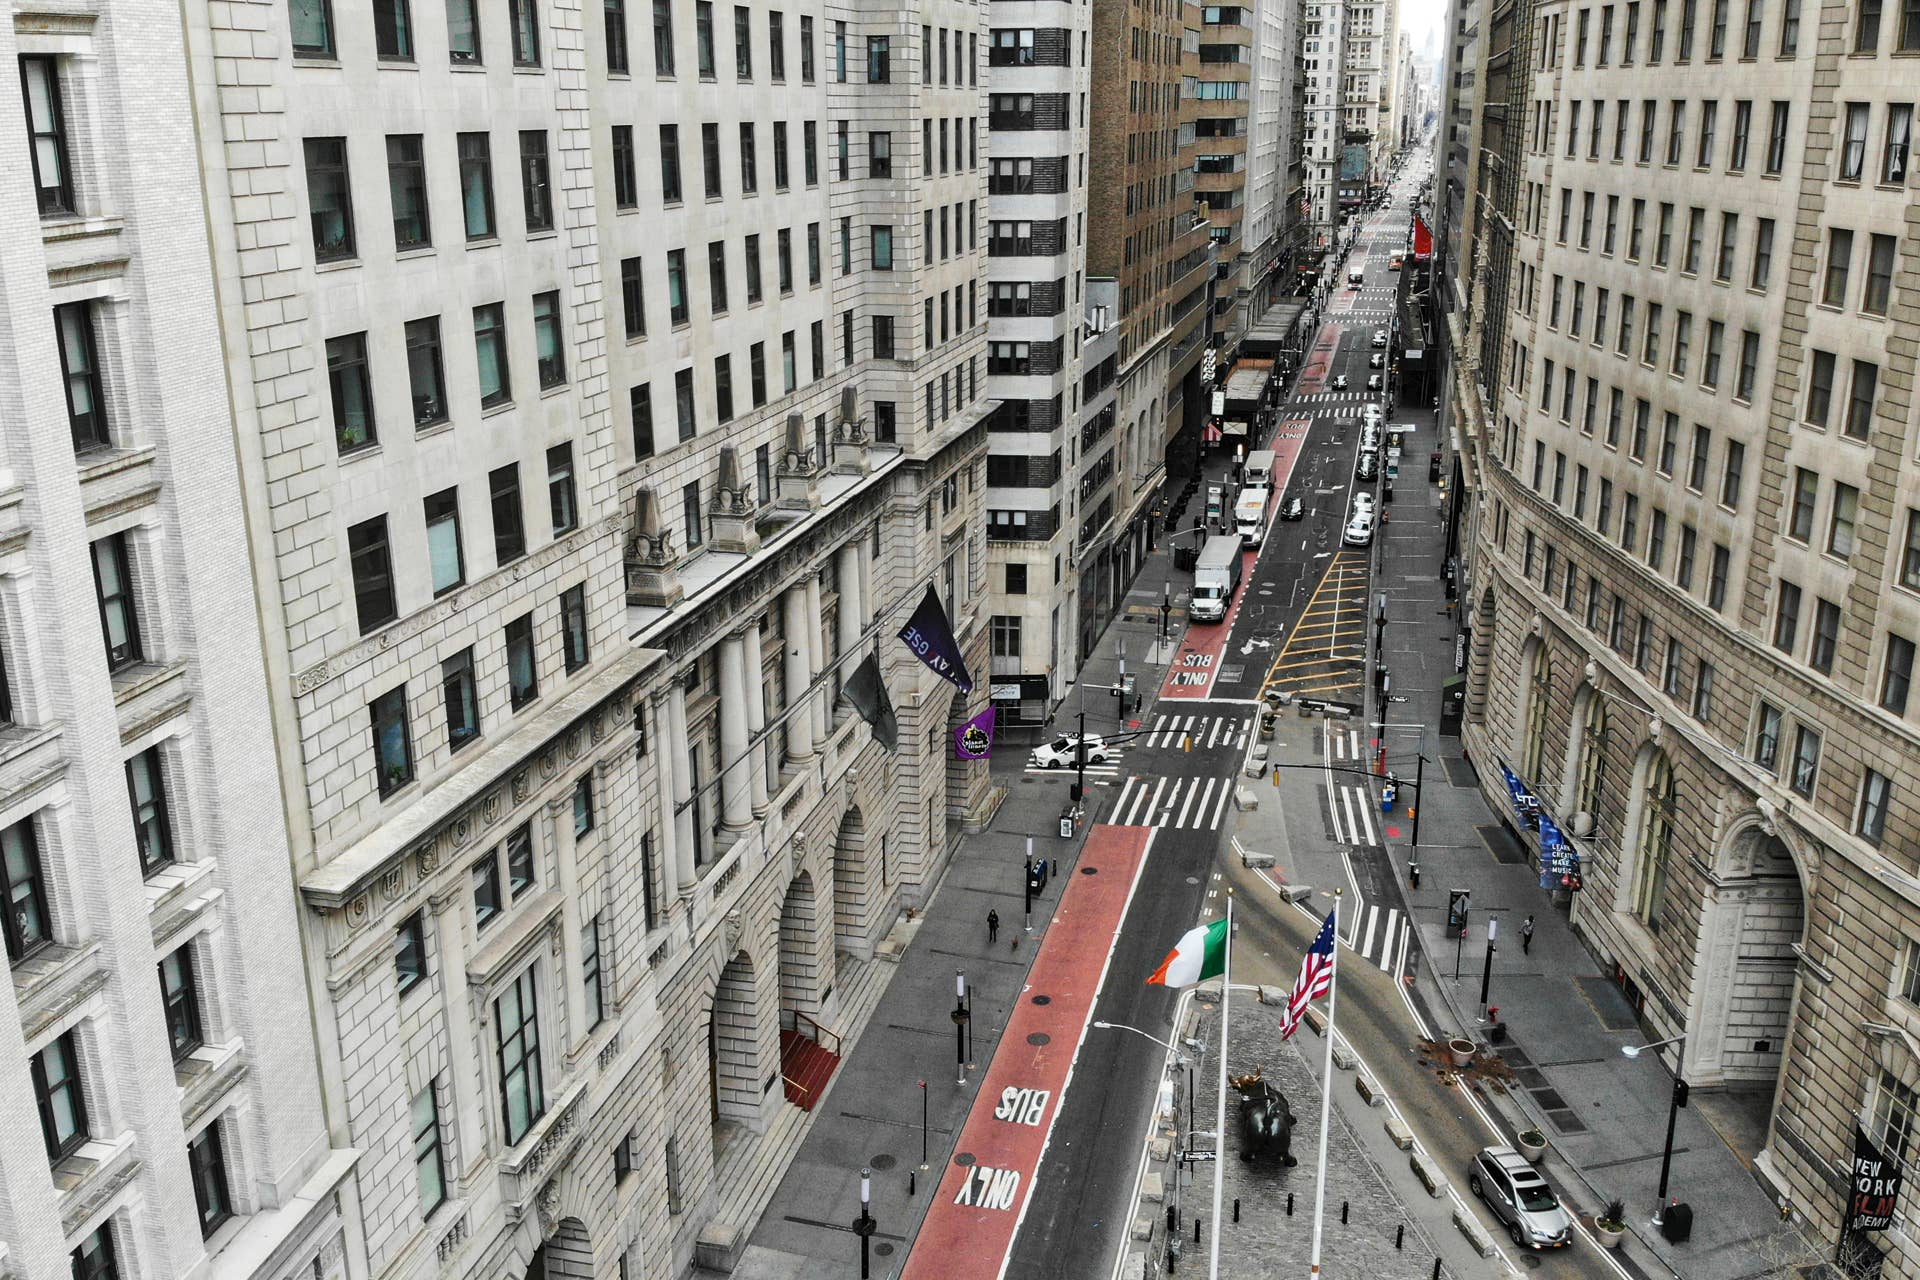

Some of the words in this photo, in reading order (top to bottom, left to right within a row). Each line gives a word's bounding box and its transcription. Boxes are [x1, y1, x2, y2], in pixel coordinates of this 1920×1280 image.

[903, 626, 929, 655] GSE
[1182, 654, 1214, 667] BUS
[1170, 672, 1209, 685] ONLY
[995, 1086, 1050, 1126] BUS
[954, 1165, 1021, 1211] ONLY
[1853, 1192, 1896, 1217] FLM
